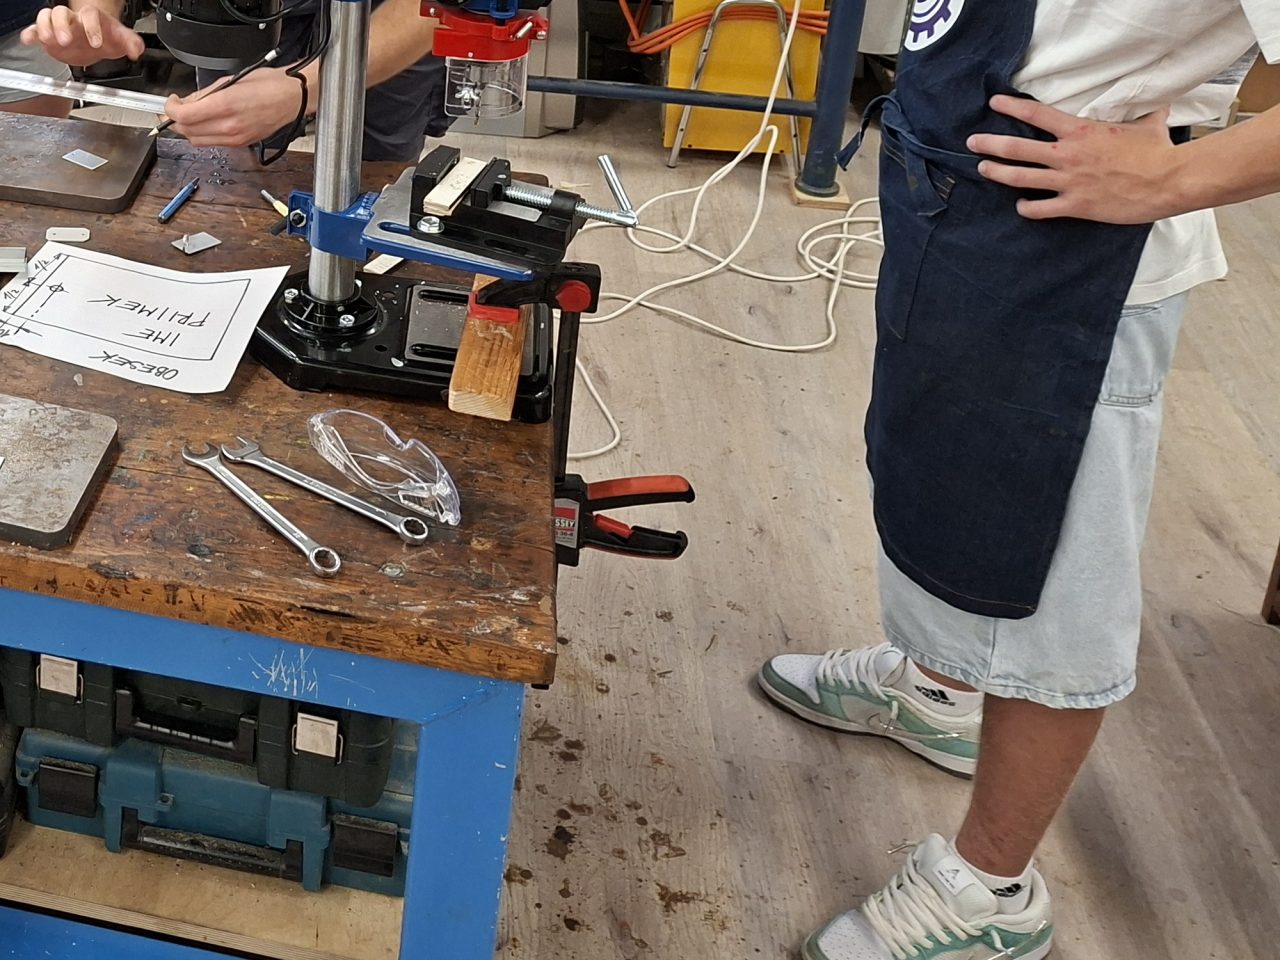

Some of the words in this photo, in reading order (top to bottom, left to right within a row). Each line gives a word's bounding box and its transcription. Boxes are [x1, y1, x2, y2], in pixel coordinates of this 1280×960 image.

[86, 294, 210, 327] PRIIMEK
[121, 328, 180, 347] IME
[88, 350, 179, 381] OBESEK
[555, 518, 575, 528] SSEY
